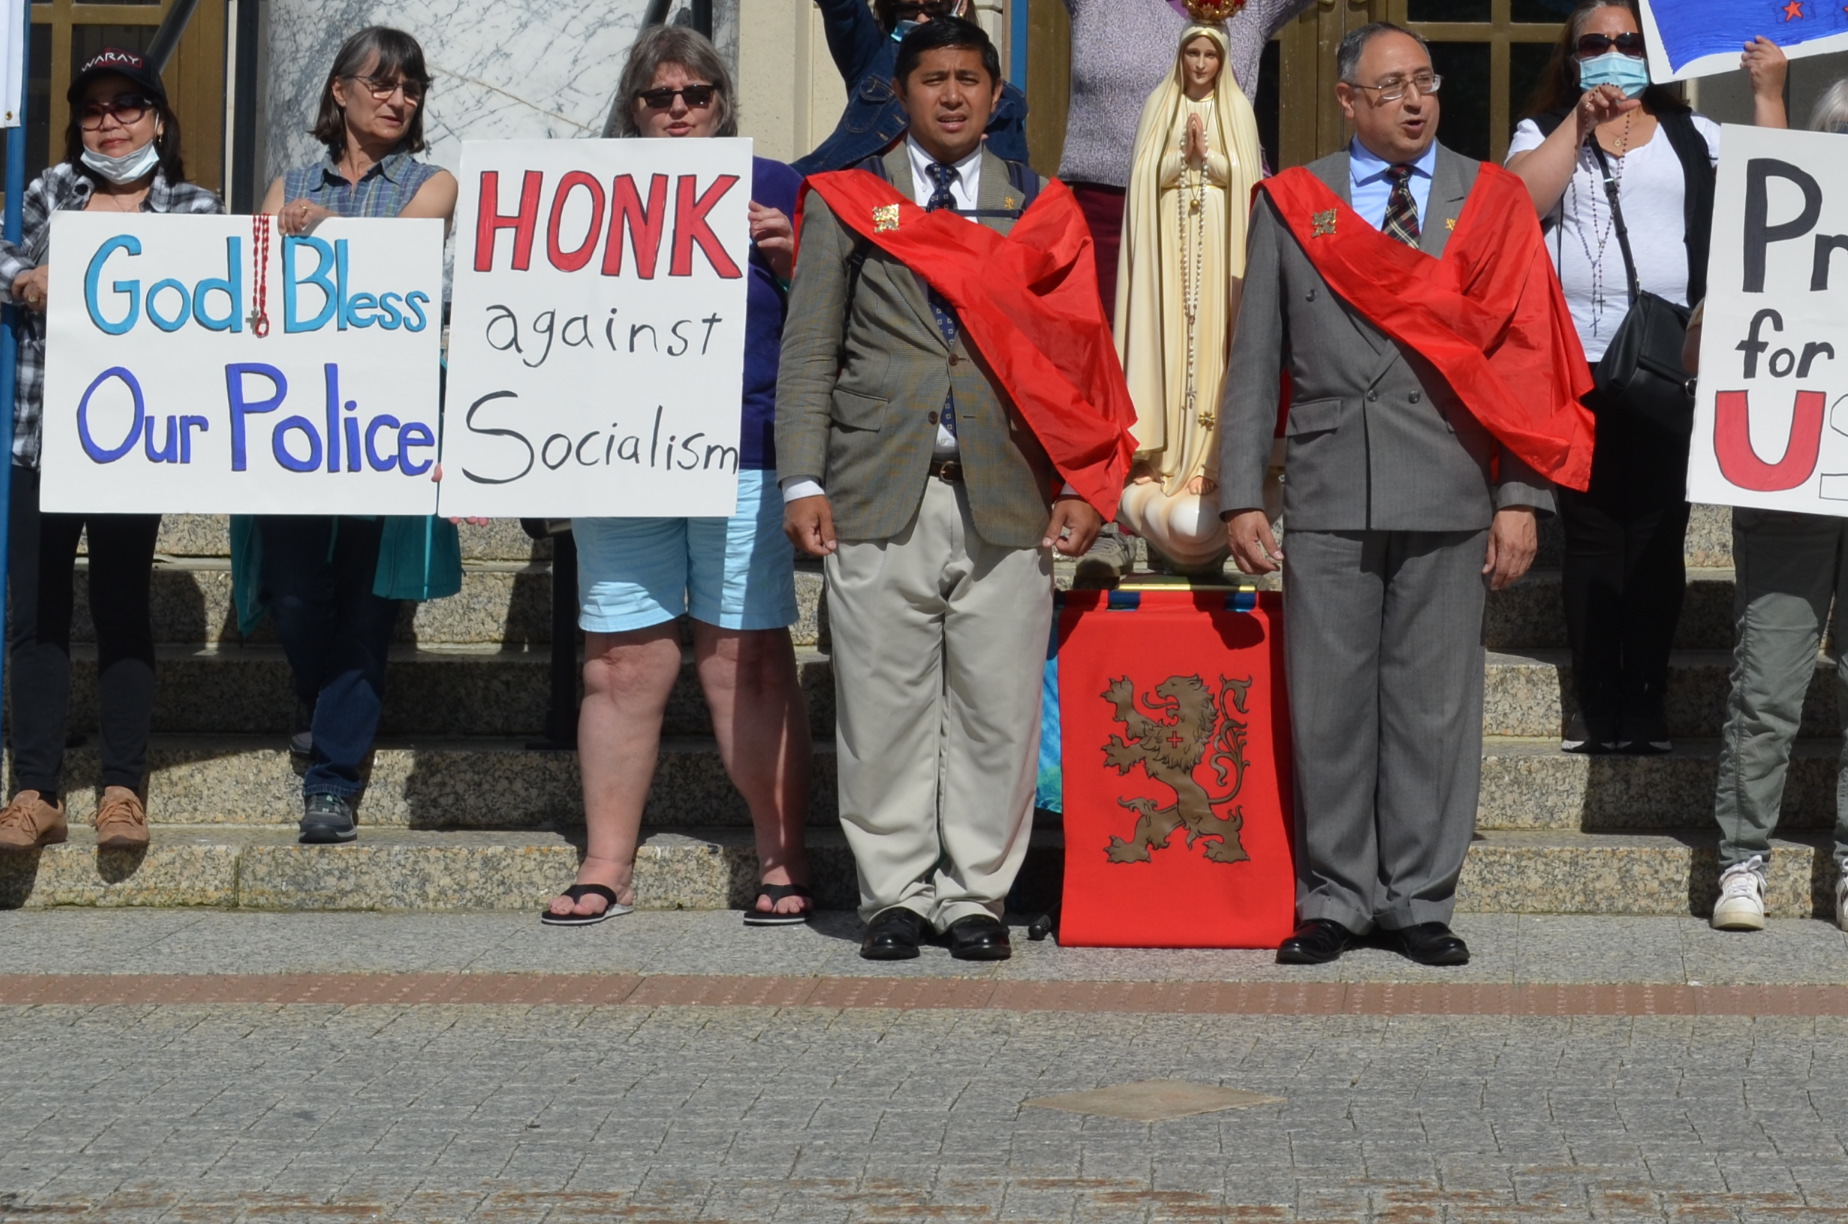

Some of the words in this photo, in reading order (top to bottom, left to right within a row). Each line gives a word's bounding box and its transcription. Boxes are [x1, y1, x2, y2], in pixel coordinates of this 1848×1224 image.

[81, 52, 139, 72] WARAY
[474, 170, 743, 280] HONK
[84, 234, 243, 335] God
[282, 236, 430, 334] Bless
[486, 305, 722, 368] against
[1735, 309, 1834, 379] for
[76, 366, 209, 464] Our
[225, 363, 435, 476] Police
[462, 391, 738, 484] Socialism
